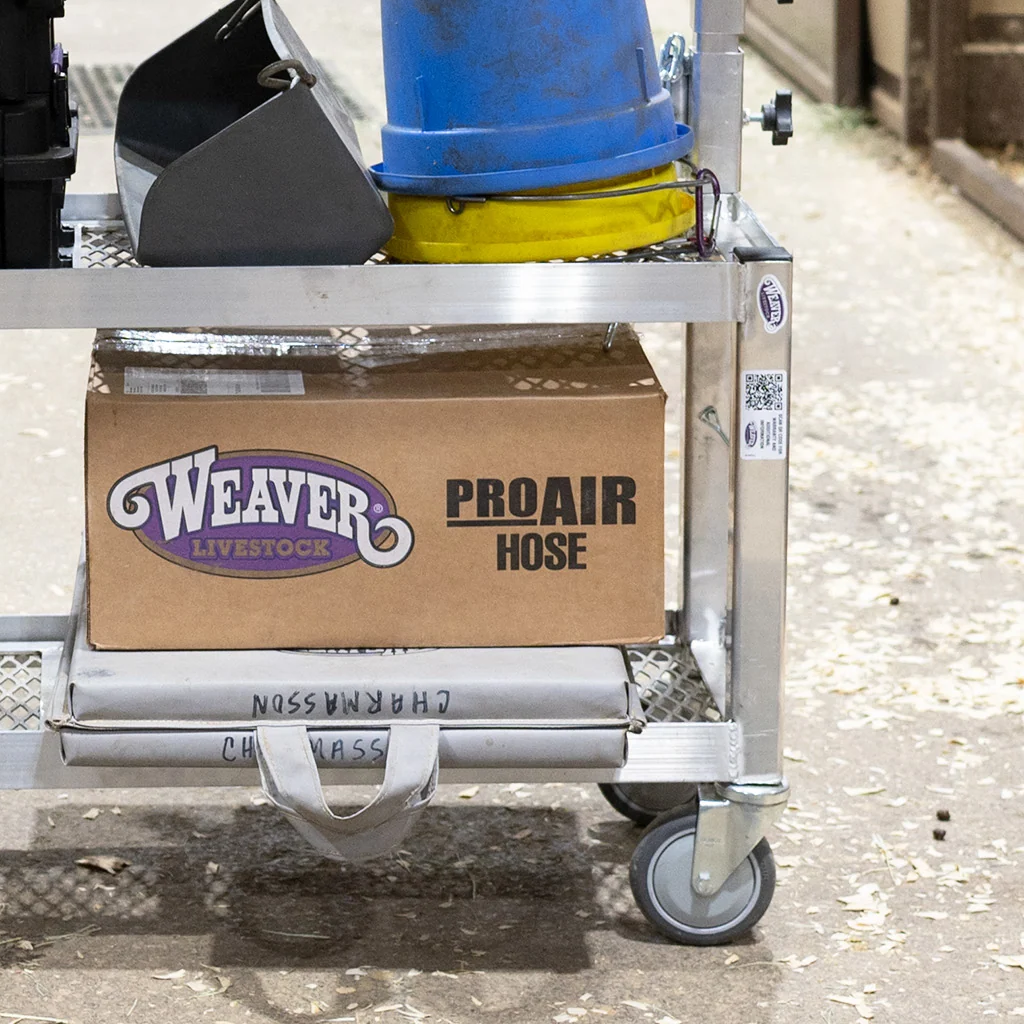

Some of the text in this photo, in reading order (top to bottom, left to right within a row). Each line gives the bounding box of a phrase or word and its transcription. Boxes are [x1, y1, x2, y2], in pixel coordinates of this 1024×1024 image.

[764, 279, 782, 330] WEAVER
[109, 446, 414, 567] WEAVER
[446, 476, 636, 526] PROAIR
[191, 538, 332, 559] LIVESTOCK
[497, 532, 587, 570] HOSE
[252, 690, 450, 718] CHARMASSON
